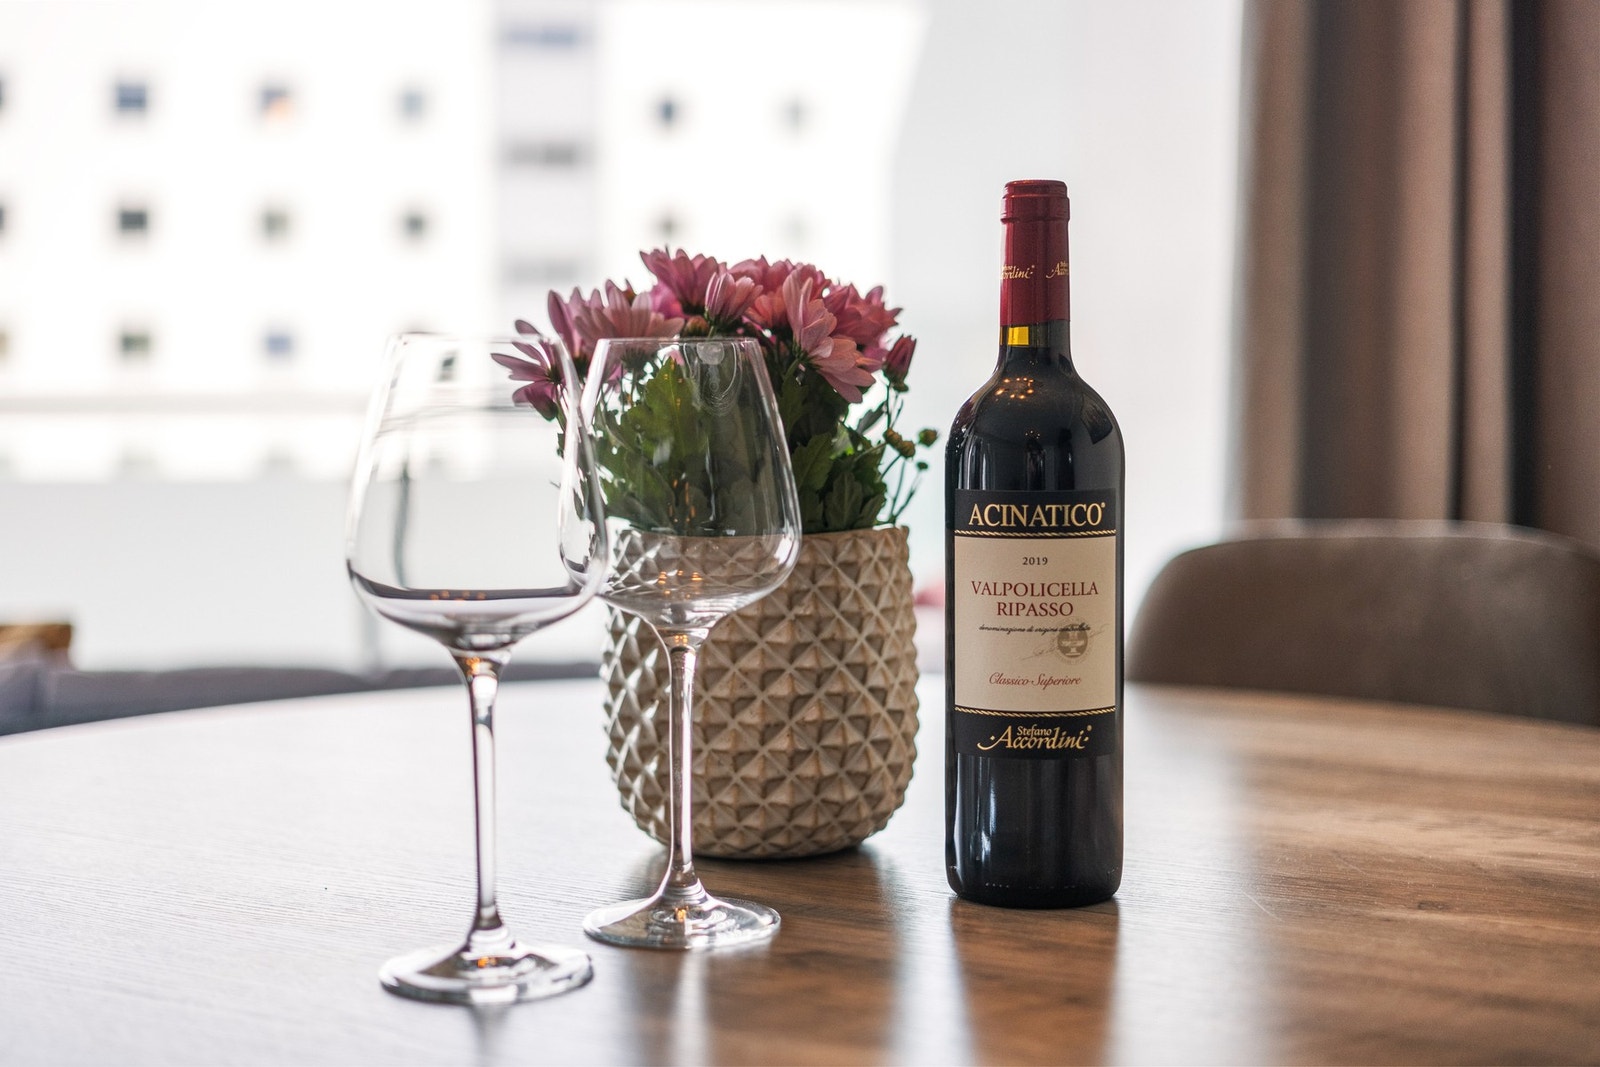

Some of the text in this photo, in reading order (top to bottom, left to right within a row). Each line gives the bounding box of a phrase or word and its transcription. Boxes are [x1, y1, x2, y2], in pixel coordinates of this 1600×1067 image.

[968, 502, 1103, 527] ACINATICO
[1022, 556, 1048, 566] 2019
[971, 581, 1099, 597] VALPOLICELLA
[996, 601, 1074, 617] RIPASSO
[978, 624, 1026, 635] denominazione
[988, 671, 1082, 690] Classico Superiore
[977, 725, 1088, 750] Accordini
[1016, 723, 1052, 738] Stefano
